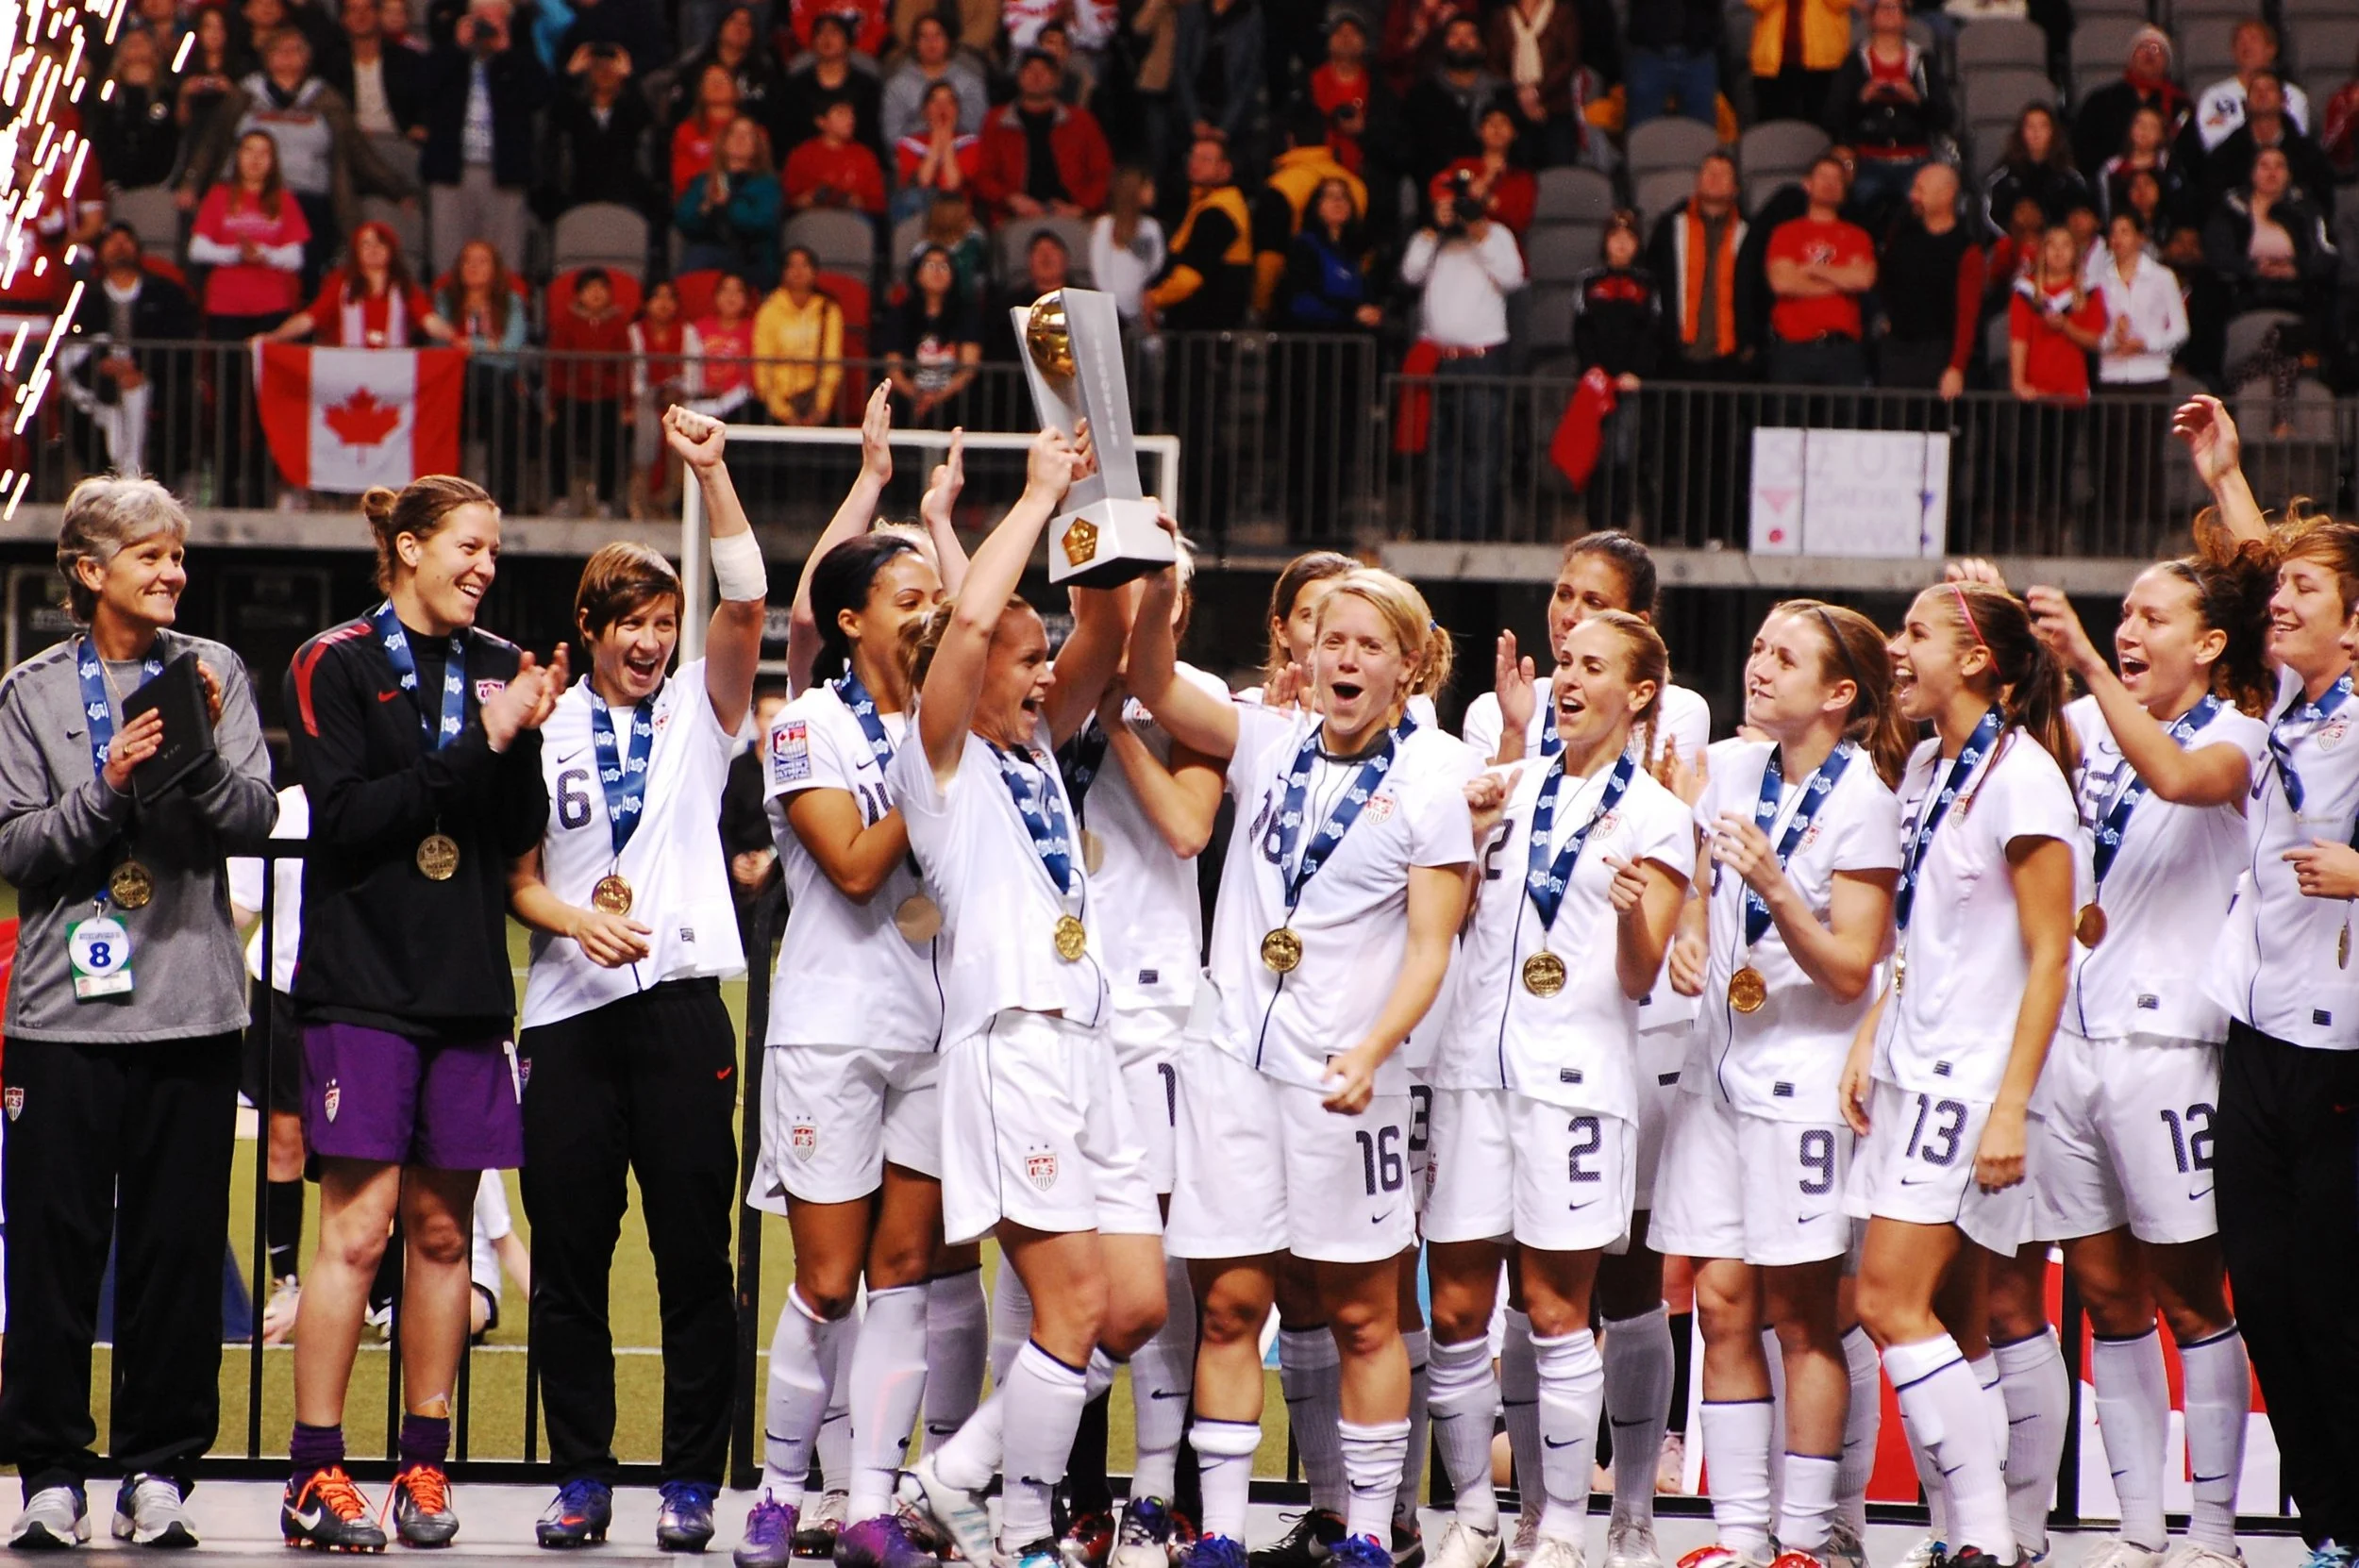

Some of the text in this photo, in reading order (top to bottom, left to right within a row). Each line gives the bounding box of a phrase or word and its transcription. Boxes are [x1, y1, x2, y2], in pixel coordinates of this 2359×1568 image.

[557, 769, 592, 830] 6
[89, 942, 111, 968] 8
[1355, 1125, 1404, 1195] 16
[1567, 1115, 1602, 1183] 2
[1799, 1129, 1835, 1196] 9
[1905, 1093, 1968, 1167] 13
[2160, 1102, 2217, 1174] 12
